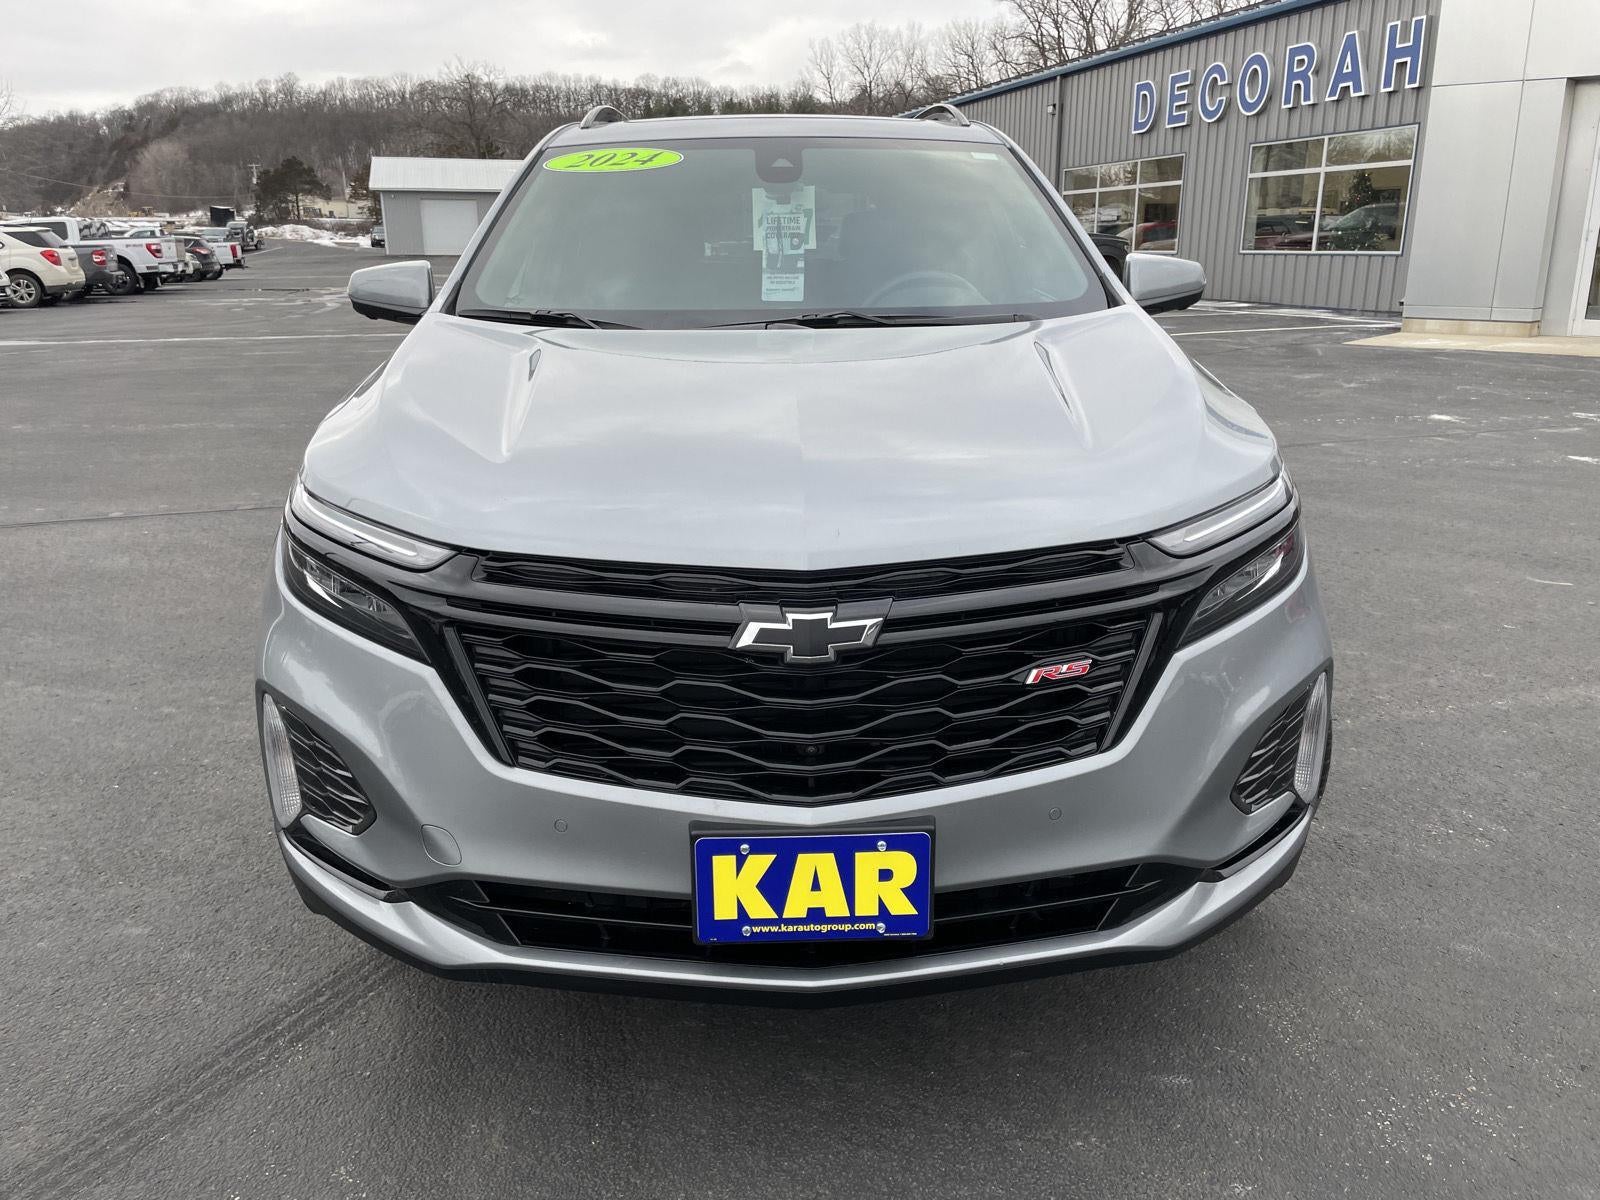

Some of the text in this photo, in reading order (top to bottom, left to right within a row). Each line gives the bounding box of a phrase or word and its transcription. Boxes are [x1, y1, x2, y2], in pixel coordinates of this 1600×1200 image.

[1132, 15, 1426, 134] DECORAH
[565, 152, 664, 168] 2024
[766, 216, 801, 225] LIFETIME
[1025, 660, 1092, 684] RS
[712, 851, 918, 920] KAR
[752, 923, 875, 934] www.karautogroup.com
